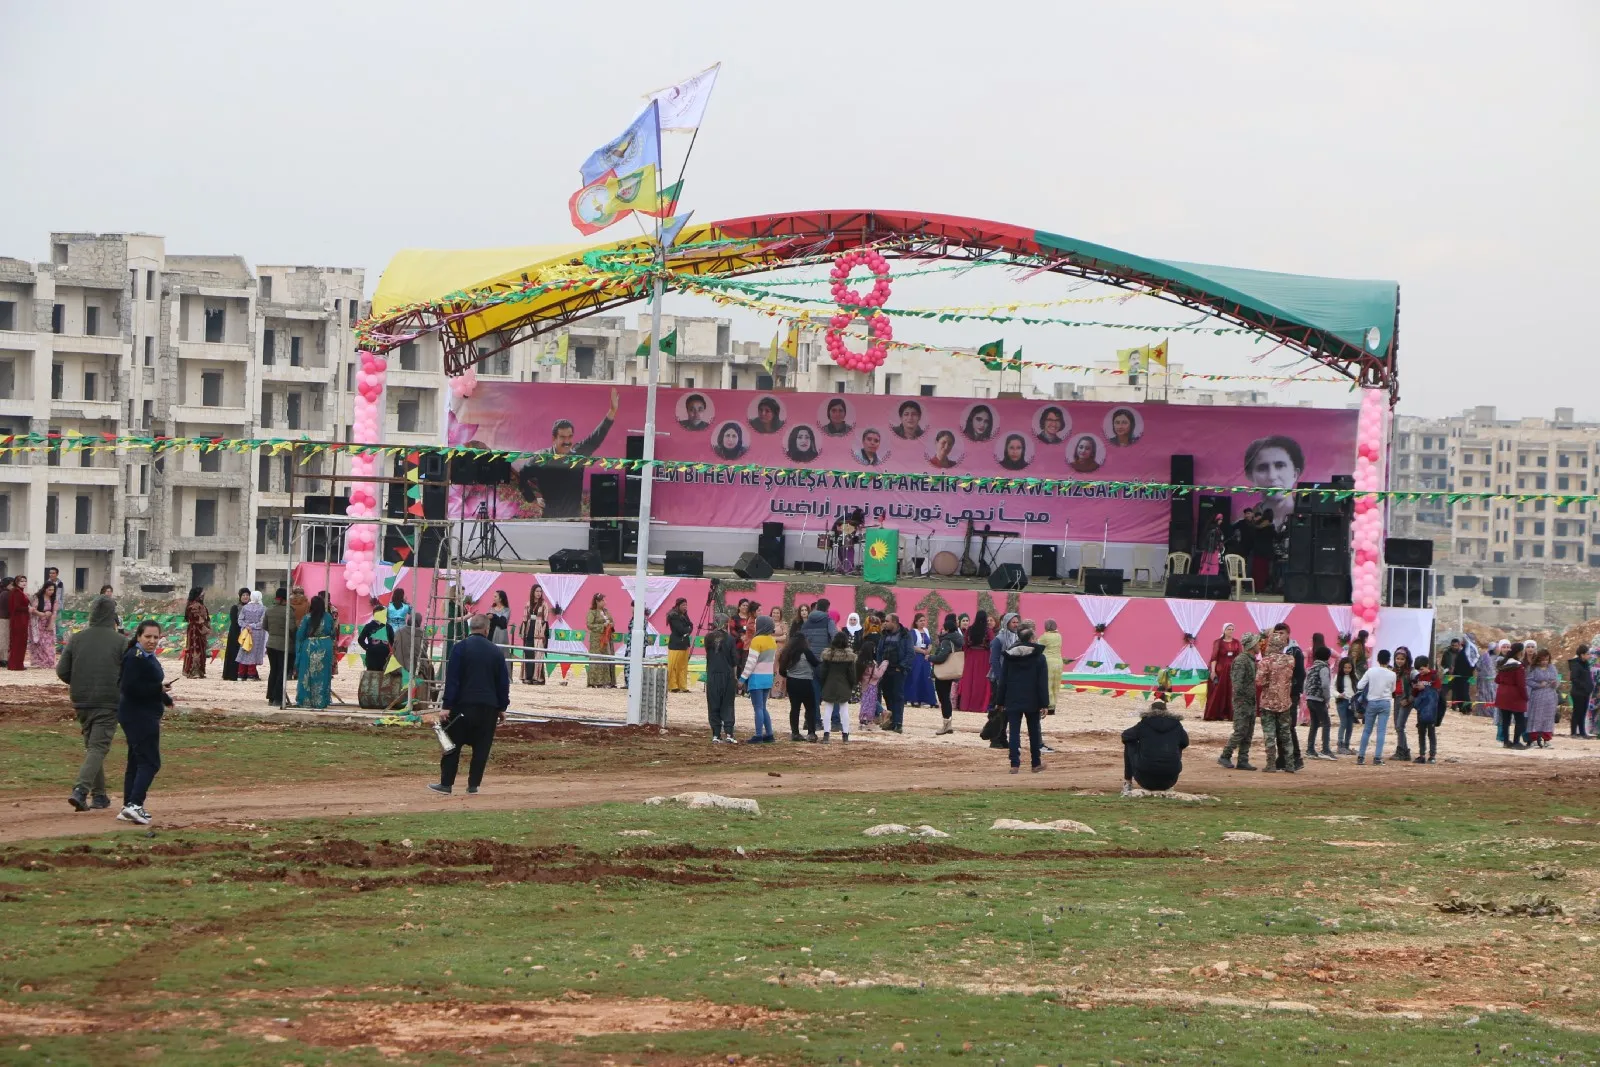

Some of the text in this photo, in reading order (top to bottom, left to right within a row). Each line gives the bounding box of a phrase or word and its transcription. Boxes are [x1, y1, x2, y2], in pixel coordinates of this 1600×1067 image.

[655, 465, 679, 483] EM
[703, 466, 736, 485] HEV
[872, 470, 957, 493] BPARÊZİN
[770, 497, 831, 518] أراضينا
[889, 503, 942, 521] ثورتنا
[945, 507, 995, 528] نحمي
